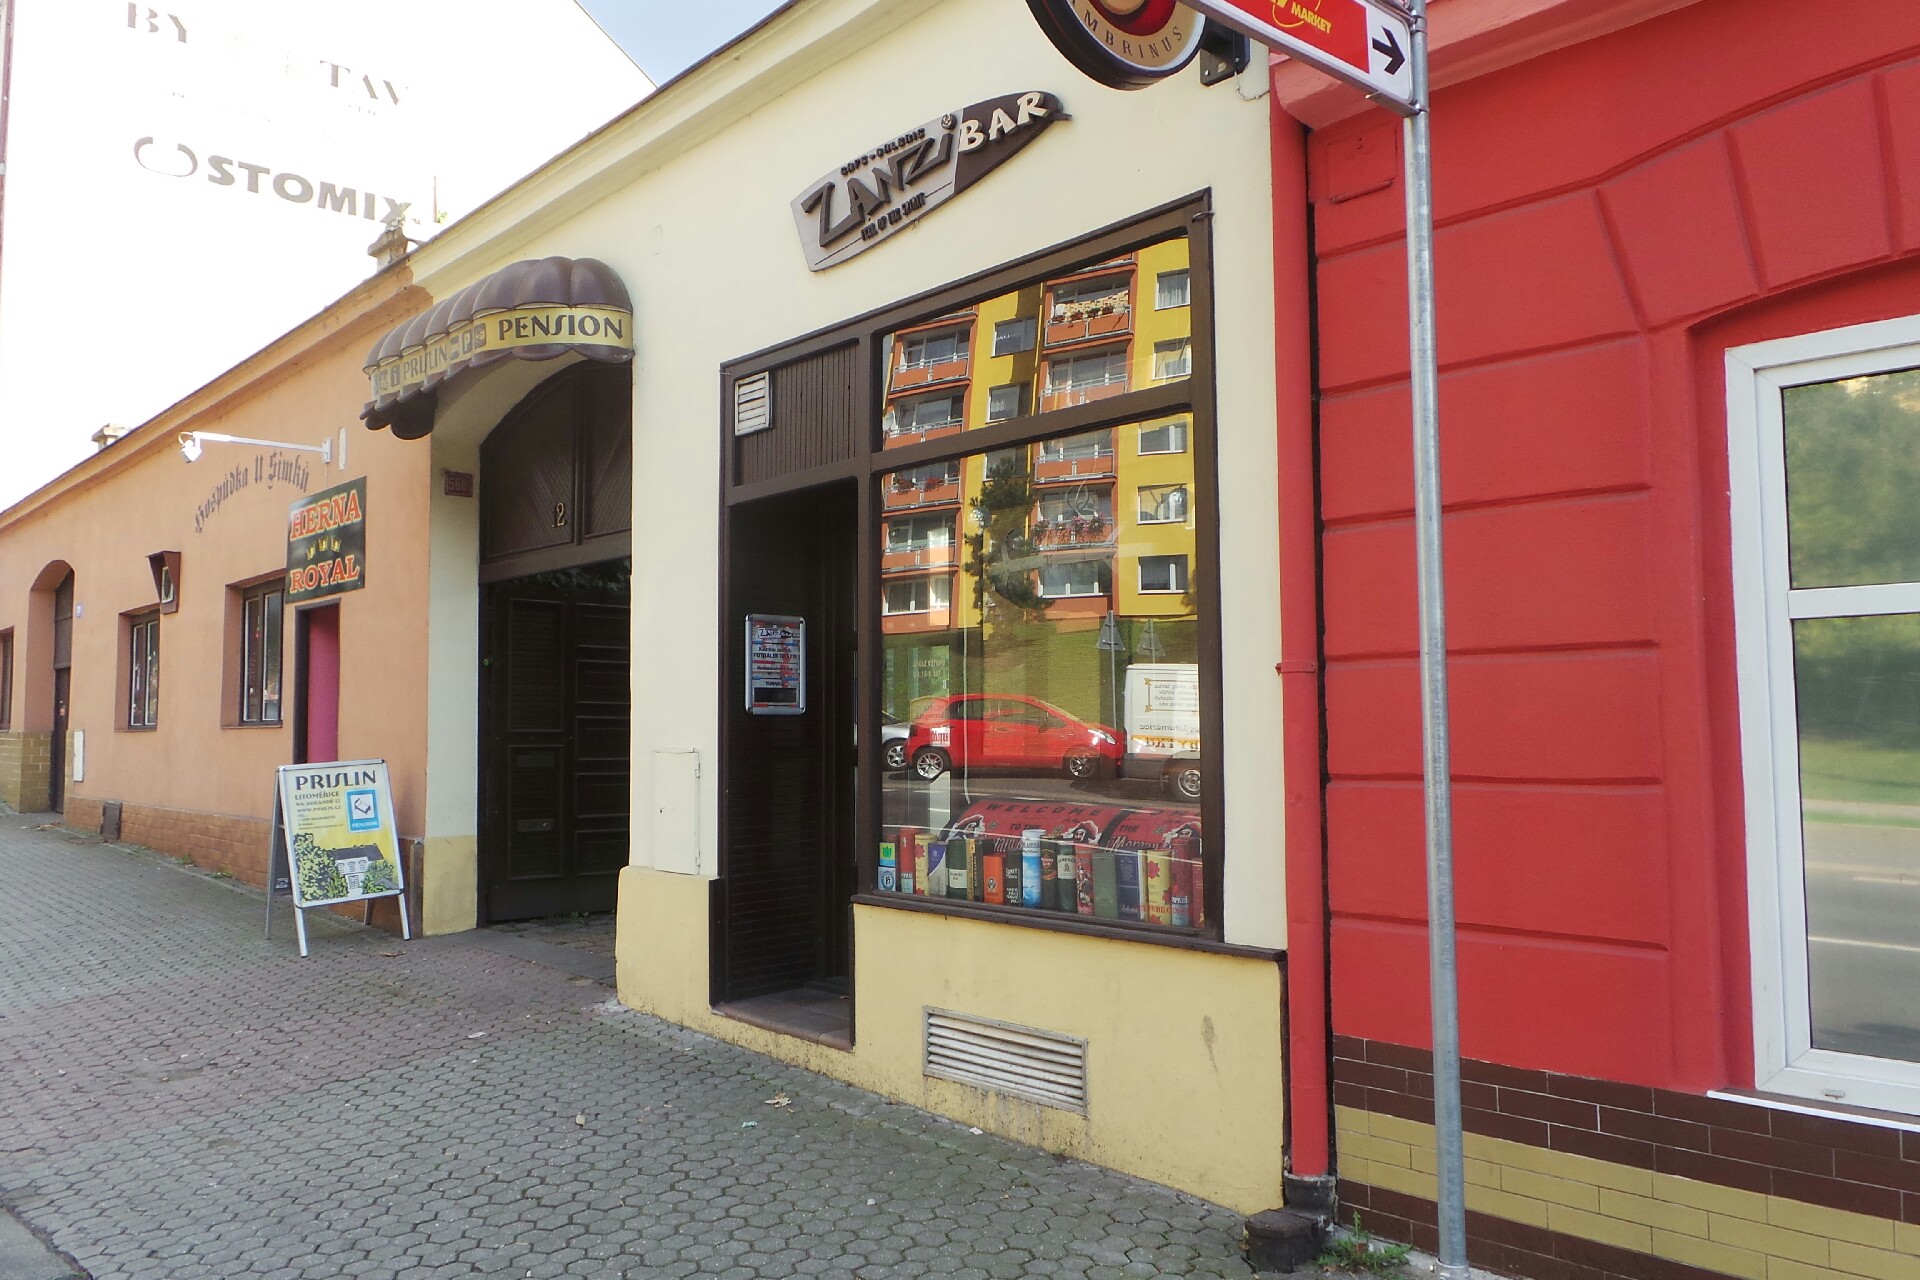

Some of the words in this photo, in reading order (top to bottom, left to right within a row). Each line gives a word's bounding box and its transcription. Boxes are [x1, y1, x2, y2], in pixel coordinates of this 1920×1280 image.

[1071, 0, 1184, 59] MBRINUS
[1291, 2, 1332, 34] MARKET
[958, 91, 1049, 152] BAR
[207, 154, 412, 225] STOMIX
[498, 314, 624, 342] PENSION
[290, 489, 361, 541] HERNA
[289, 555, 360, 594] ROYAL
[295, 770, 377, 791] PRISLIN
[986, 803, 1104, 817] WELCOME
[1010, 823, 1021, 831] TO
[1119, 825, 1140, 833] THE
